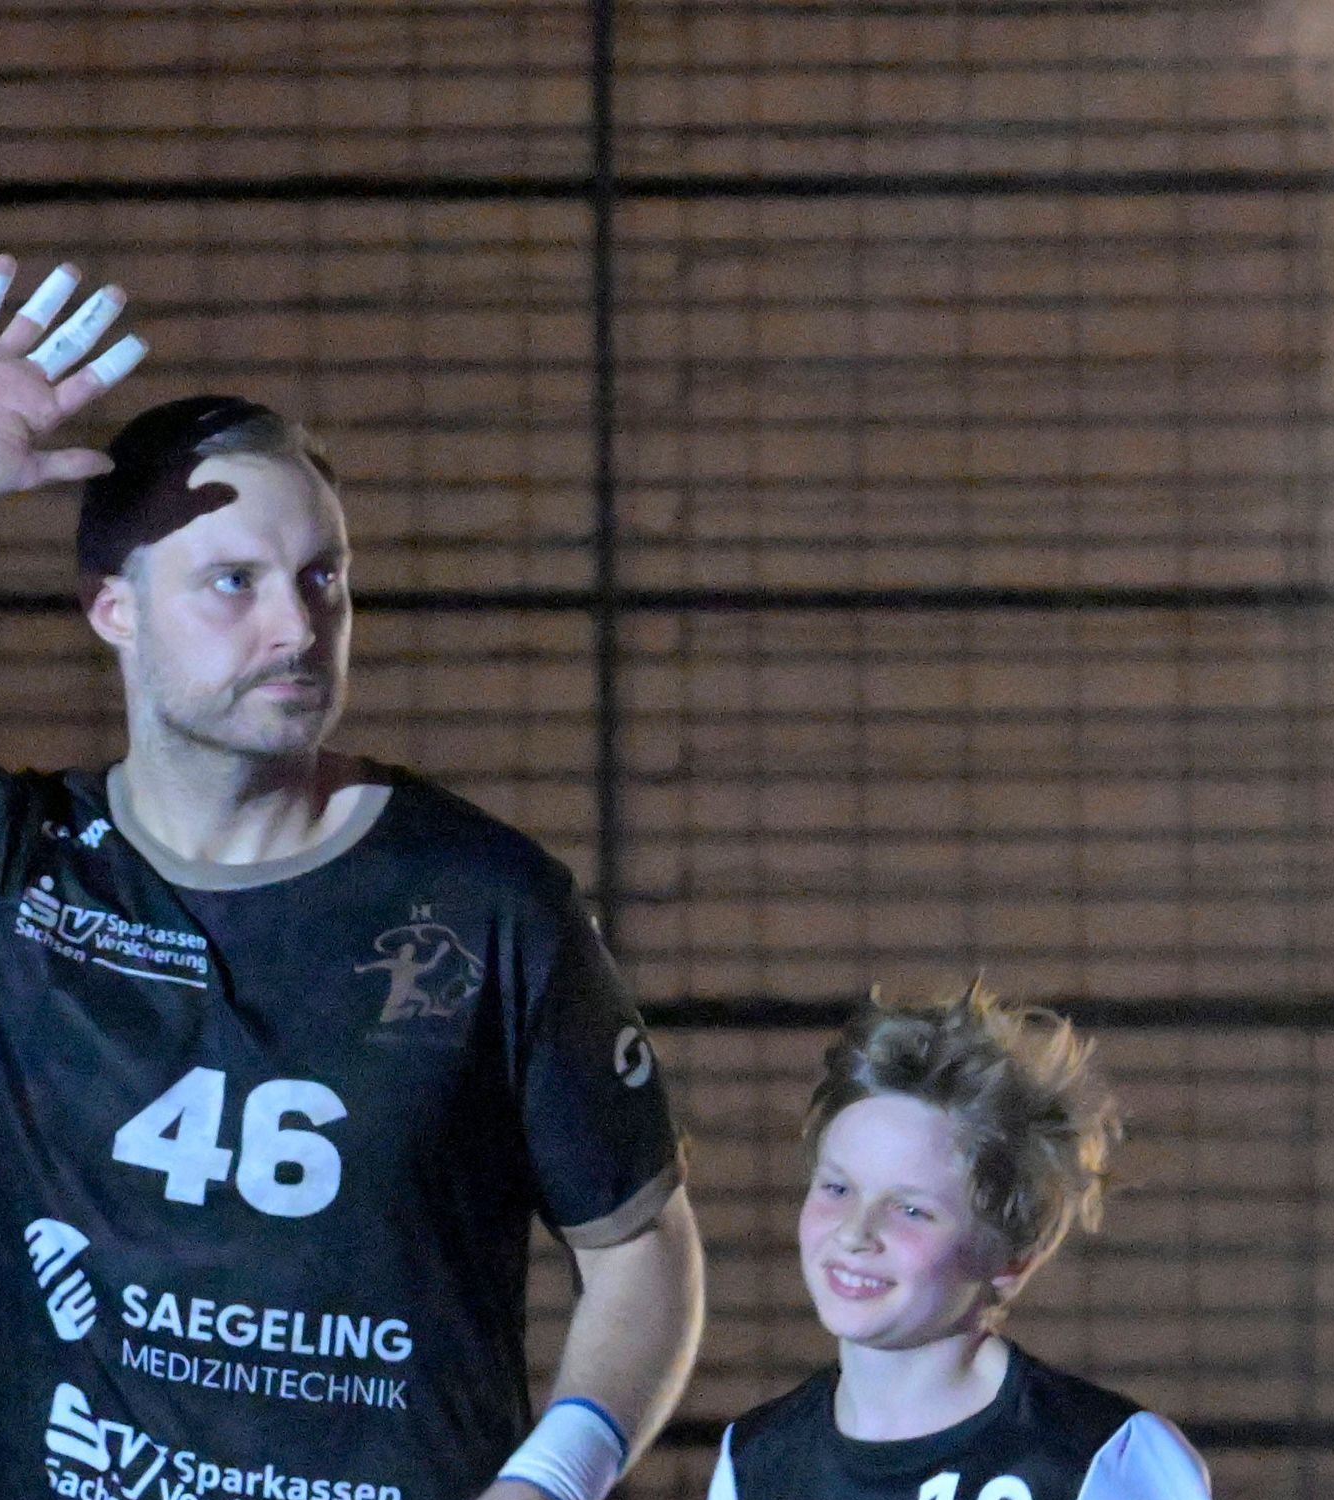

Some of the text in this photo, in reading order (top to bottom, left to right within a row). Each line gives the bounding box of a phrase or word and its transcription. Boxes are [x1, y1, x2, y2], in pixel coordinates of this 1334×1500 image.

[94, 932, 208, 974] Versicherung
[106, 913, 208, 950] Sparkassen
[111, 1064, 348, 1218] 46
[120, 1283, 413, 1361] SAEGELING
[120, 1337, 408, 1410] MEDIZINTECHNIK
